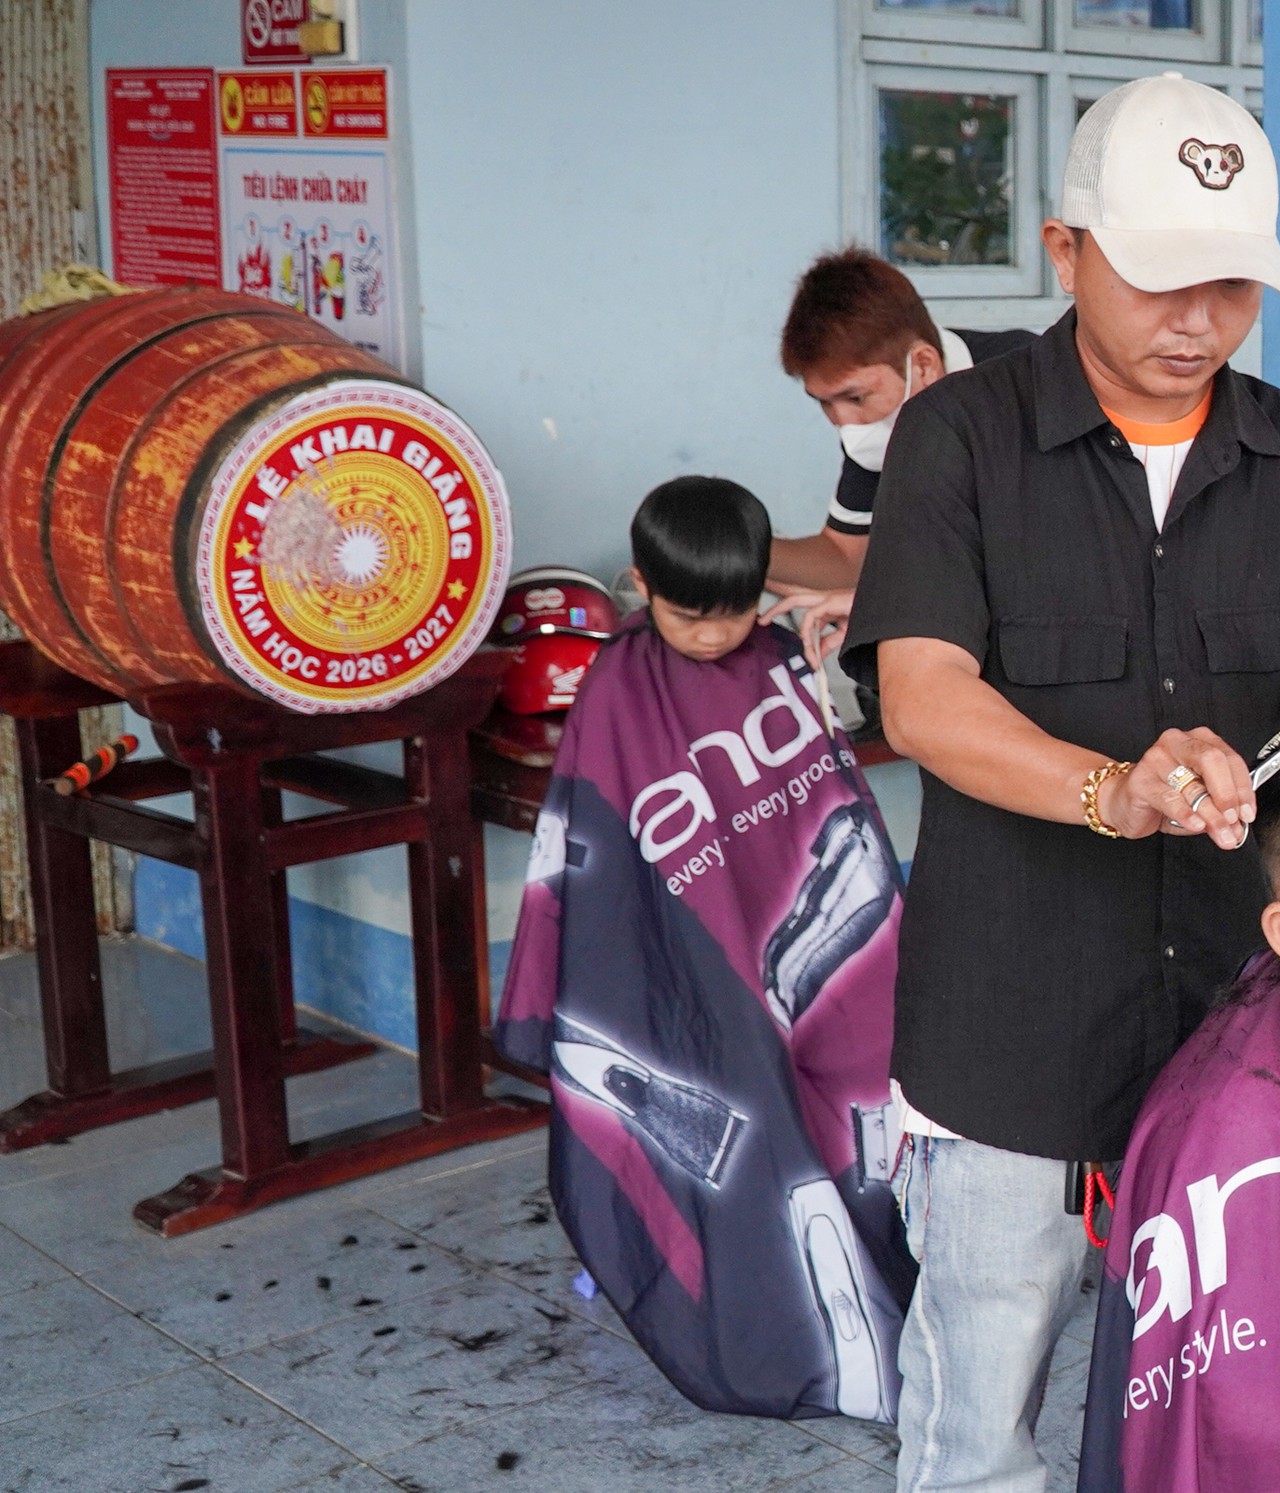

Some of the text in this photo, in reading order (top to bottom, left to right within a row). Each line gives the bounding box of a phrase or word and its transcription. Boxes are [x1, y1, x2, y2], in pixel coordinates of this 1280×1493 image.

[289, 424, 395, 471] KHAI
[401, 440, 473, 560] GIẢNG
[231, 568, 272, 637] NĂM
[262, 632, 321, 679] HỌC
[325, 654, 388, 683] 2026
[404, 603, 454, 660] 2027
[629, 654, 845, 864] andi
[666, 838, 725, 896] every
[731, 787, 789, 834] every
[1123, 1357, 1175, 1419] ery
[1180, 1309, 1267, 1380] style.
